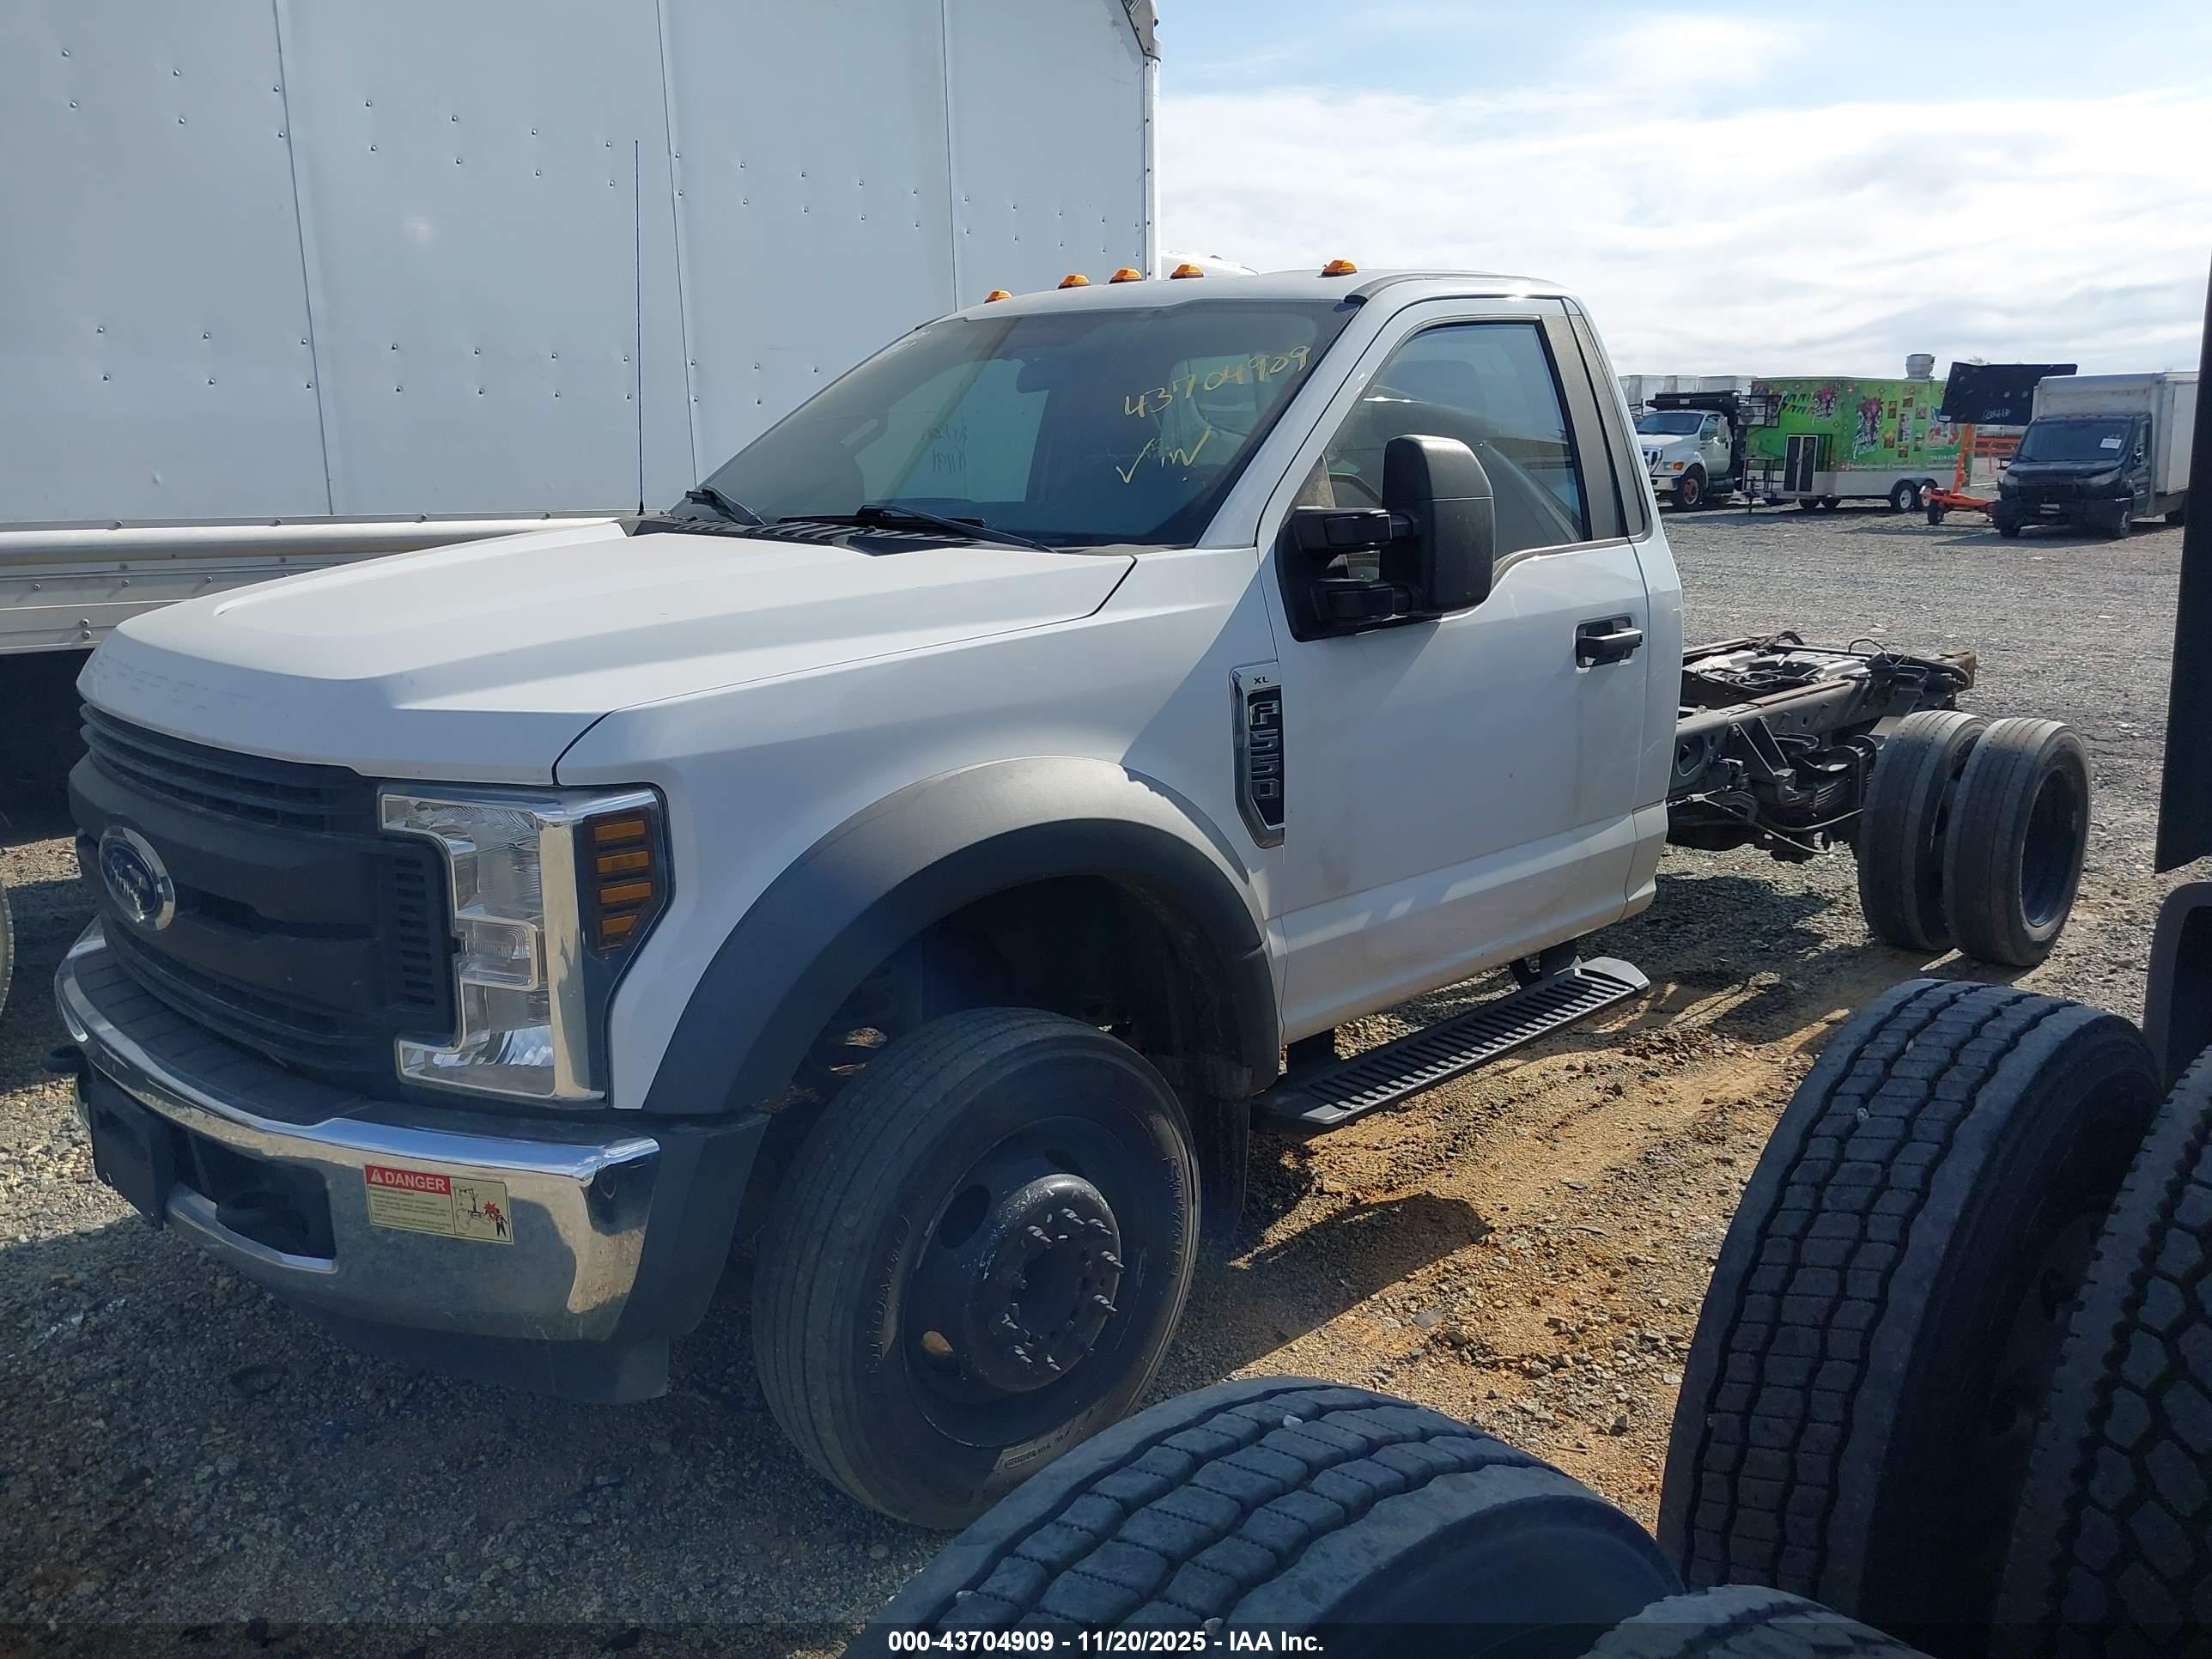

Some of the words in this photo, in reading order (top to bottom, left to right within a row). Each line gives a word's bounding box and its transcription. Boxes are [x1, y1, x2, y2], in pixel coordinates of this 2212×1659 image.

[1124, 345, 1311, 418] 43704909
[1253, 676, 1269, 685] XL
[386, 1171, 446, 1192] DANGER
